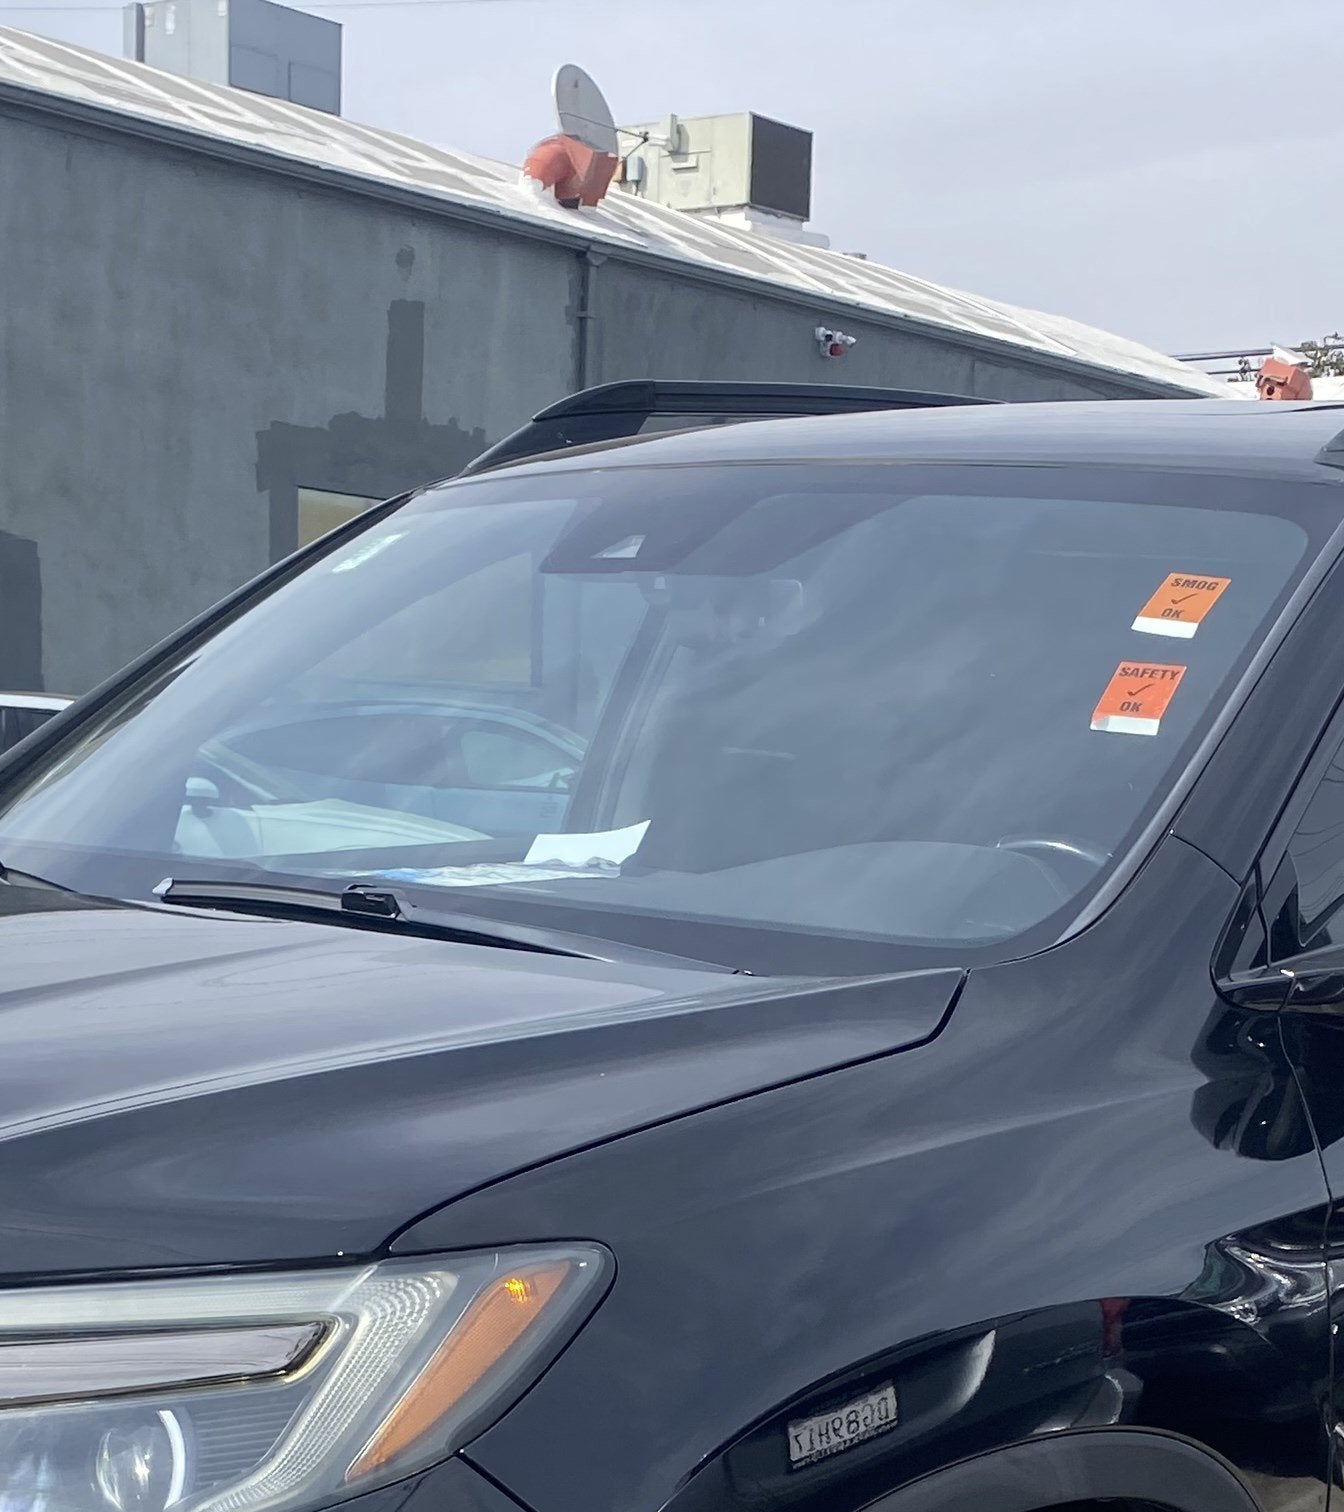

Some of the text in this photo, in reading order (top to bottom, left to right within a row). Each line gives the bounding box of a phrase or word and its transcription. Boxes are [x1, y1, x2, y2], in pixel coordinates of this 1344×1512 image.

[1170, 578, 1219, 591] SMOG
[1160, 608, 1185, 619] OK
[1118, 666, 1181, 680] SAFETY
[1119, 701, 1143, 713] OK
